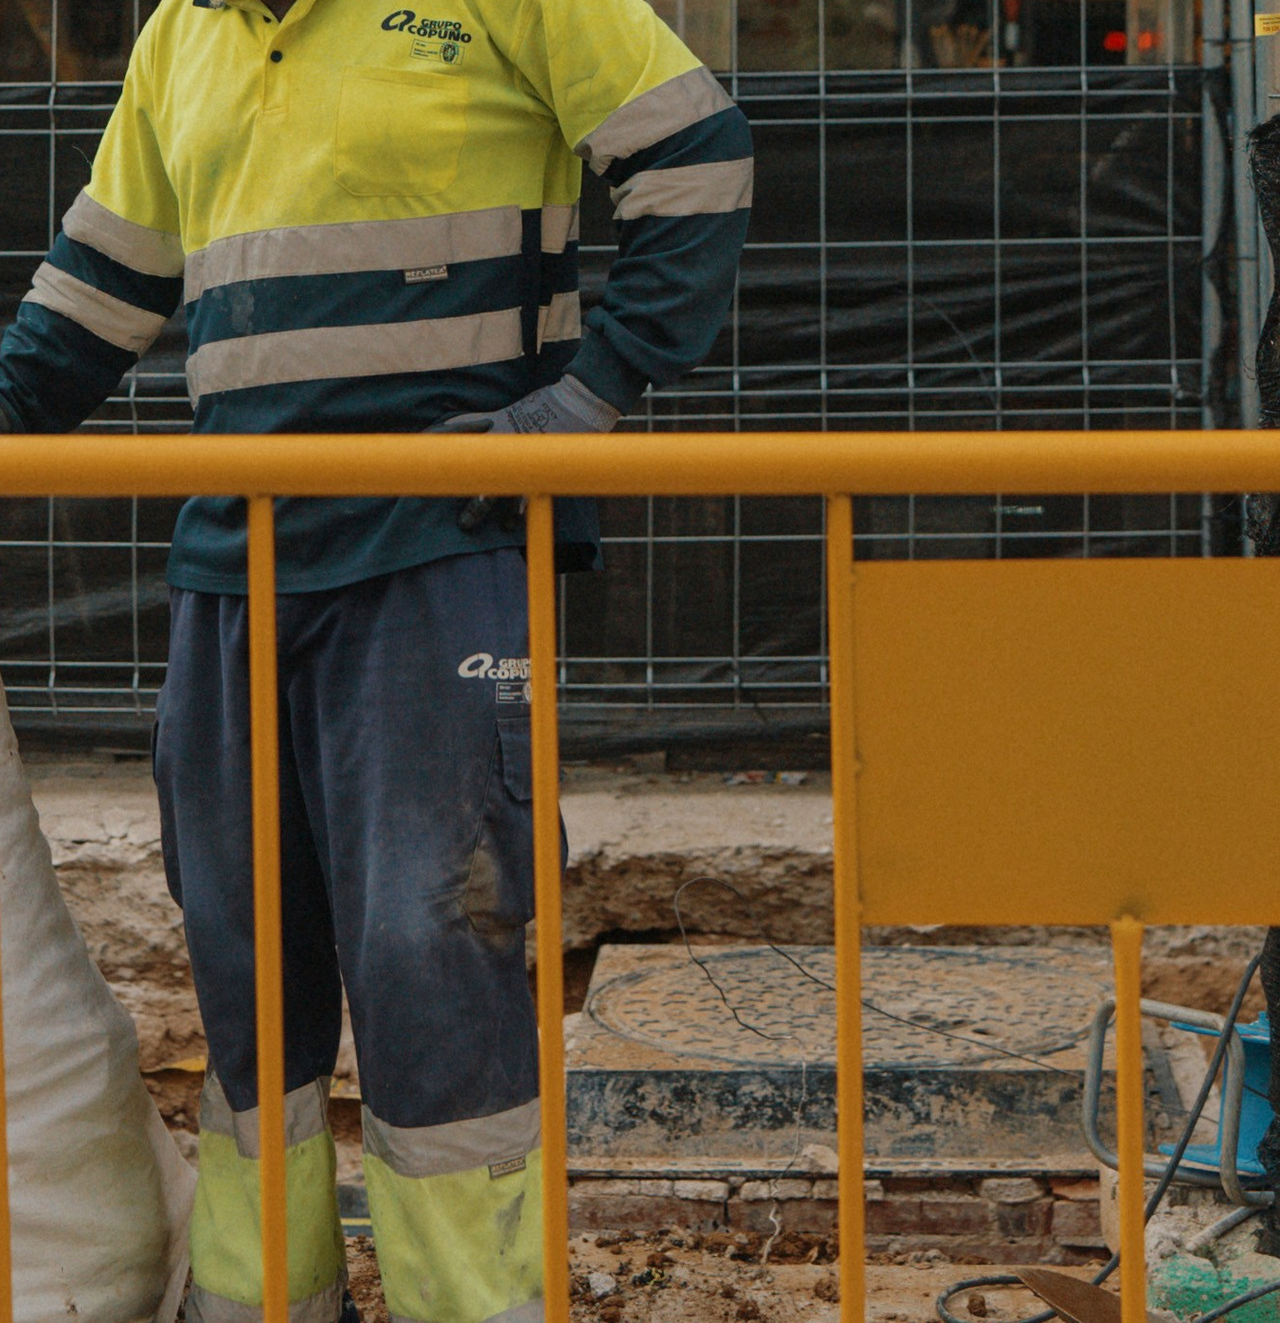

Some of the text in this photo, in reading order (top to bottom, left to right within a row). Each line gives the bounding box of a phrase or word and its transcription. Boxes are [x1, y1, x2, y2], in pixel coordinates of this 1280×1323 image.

[421, 19, 462, 31] GRUPO
[407, 25, 472, 43] COPUNO
[499, 659, 532, 668] GRUP
